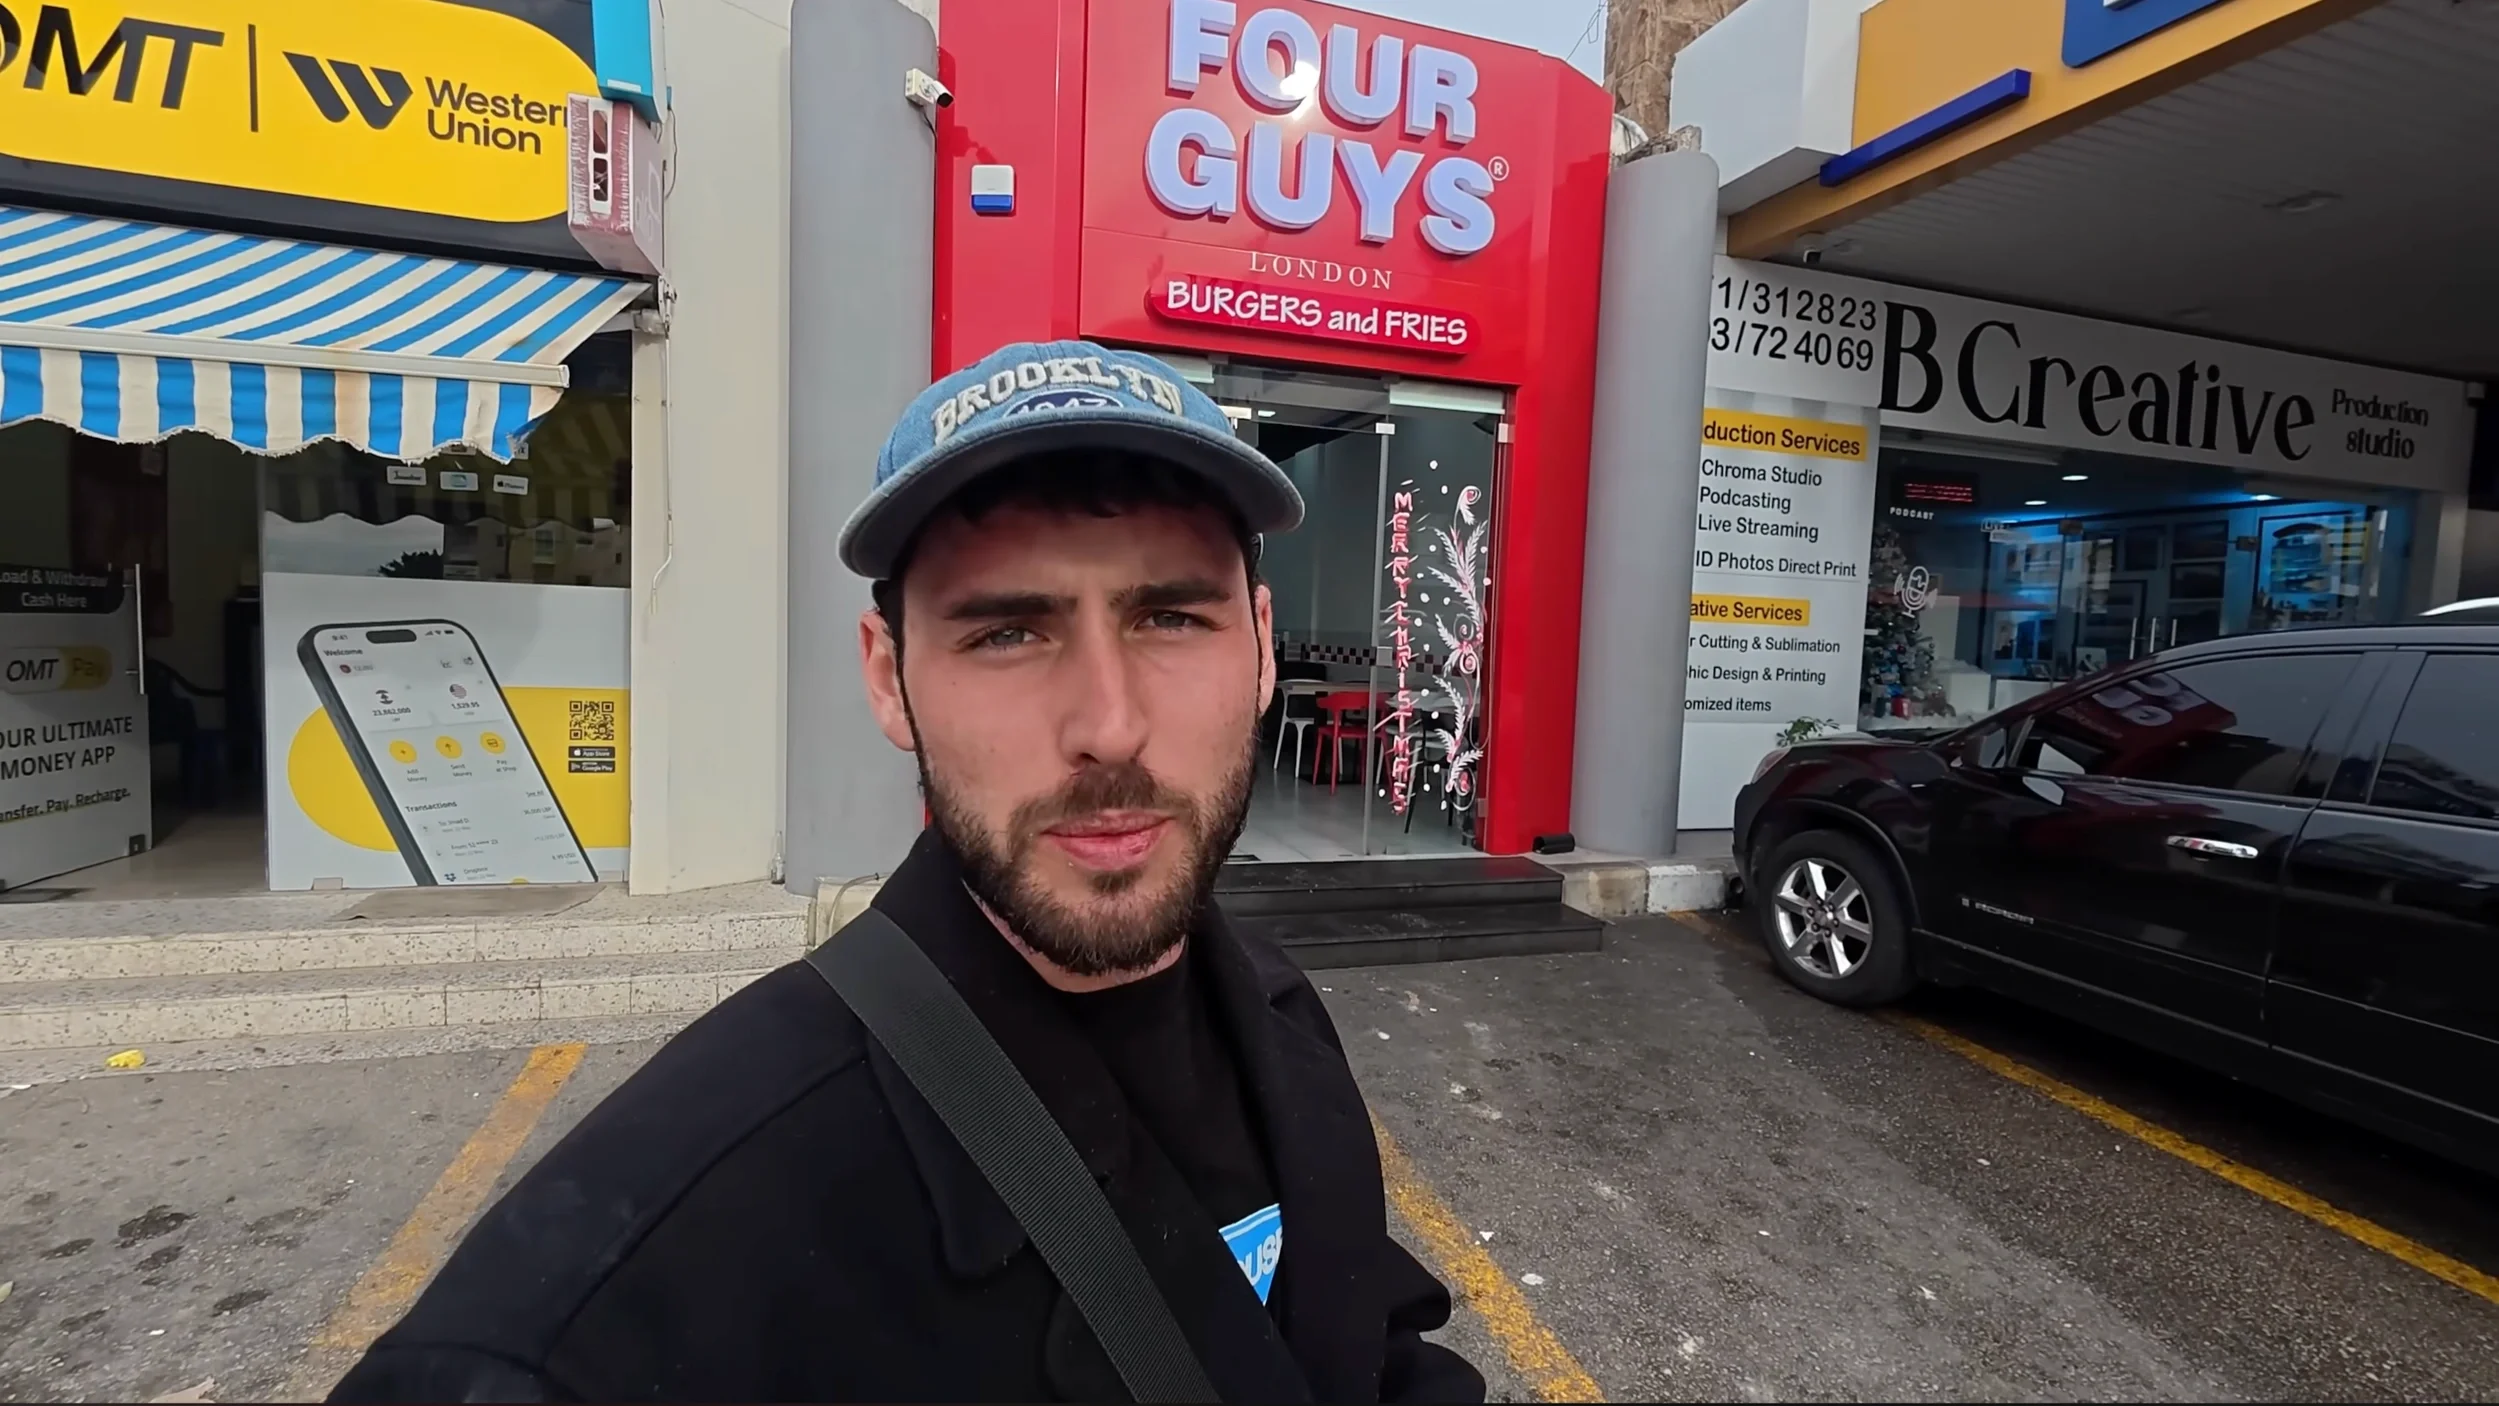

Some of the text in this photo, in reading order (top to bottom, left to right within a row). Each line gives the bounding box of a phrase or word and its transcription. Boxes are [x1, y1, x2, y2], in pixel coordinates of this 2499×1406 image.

[1167, 0, 1479, 143] FOUR
[425, 76, 568, 127] Wester
[427, 109, 541, 155] Union
[1146, 107, 1496, 255] GUYS
[1249, 251, 1393, 290] LONDON
[1167, 280, 1468, 346] BURGERS and FRIES
[1711, 275, 1877, 331] 1/312823
[1708, 317, 1874, 371] 3/724069
[931, 357, 1184, 447] BROOKLYN
[2331, 388, 2429, 427] Production
[1704, 421, 1861, 455] duction Services
[2346, 427, 2415, 459] studio
[1701, 459, 1822, 486] Chroma Studio
[1700, 486, 1791, 514] Podcasting
[1889, 507, 1935, 521] PODCAST
[1698, 514, 1819, 543] Live Streaming
[32, 569, 43, 585] &
[1696, 550, 1857, 577] ID Photos Direct Print
[22, 592, 88, 608] Cash Here
[1690, 600, 1803, 621] ative Services
[1699, 634, 1748, 653] Cutting
[1752, 636, 1762, 650] &
[1765, 636, 1840, 653] Sublimation
[6, 658, 60, 682] OMT
[1687, 665, 1826, 686] hic Design & Printing
[1684, 697, 1772, 711] omized items
[42, 716, 133, 743] ULTIMATE
[0, 746, 116, 780] MONEY APP
[75, 788, 132, 808] Recharge.
[405, 801, 458, 813] Transactions
